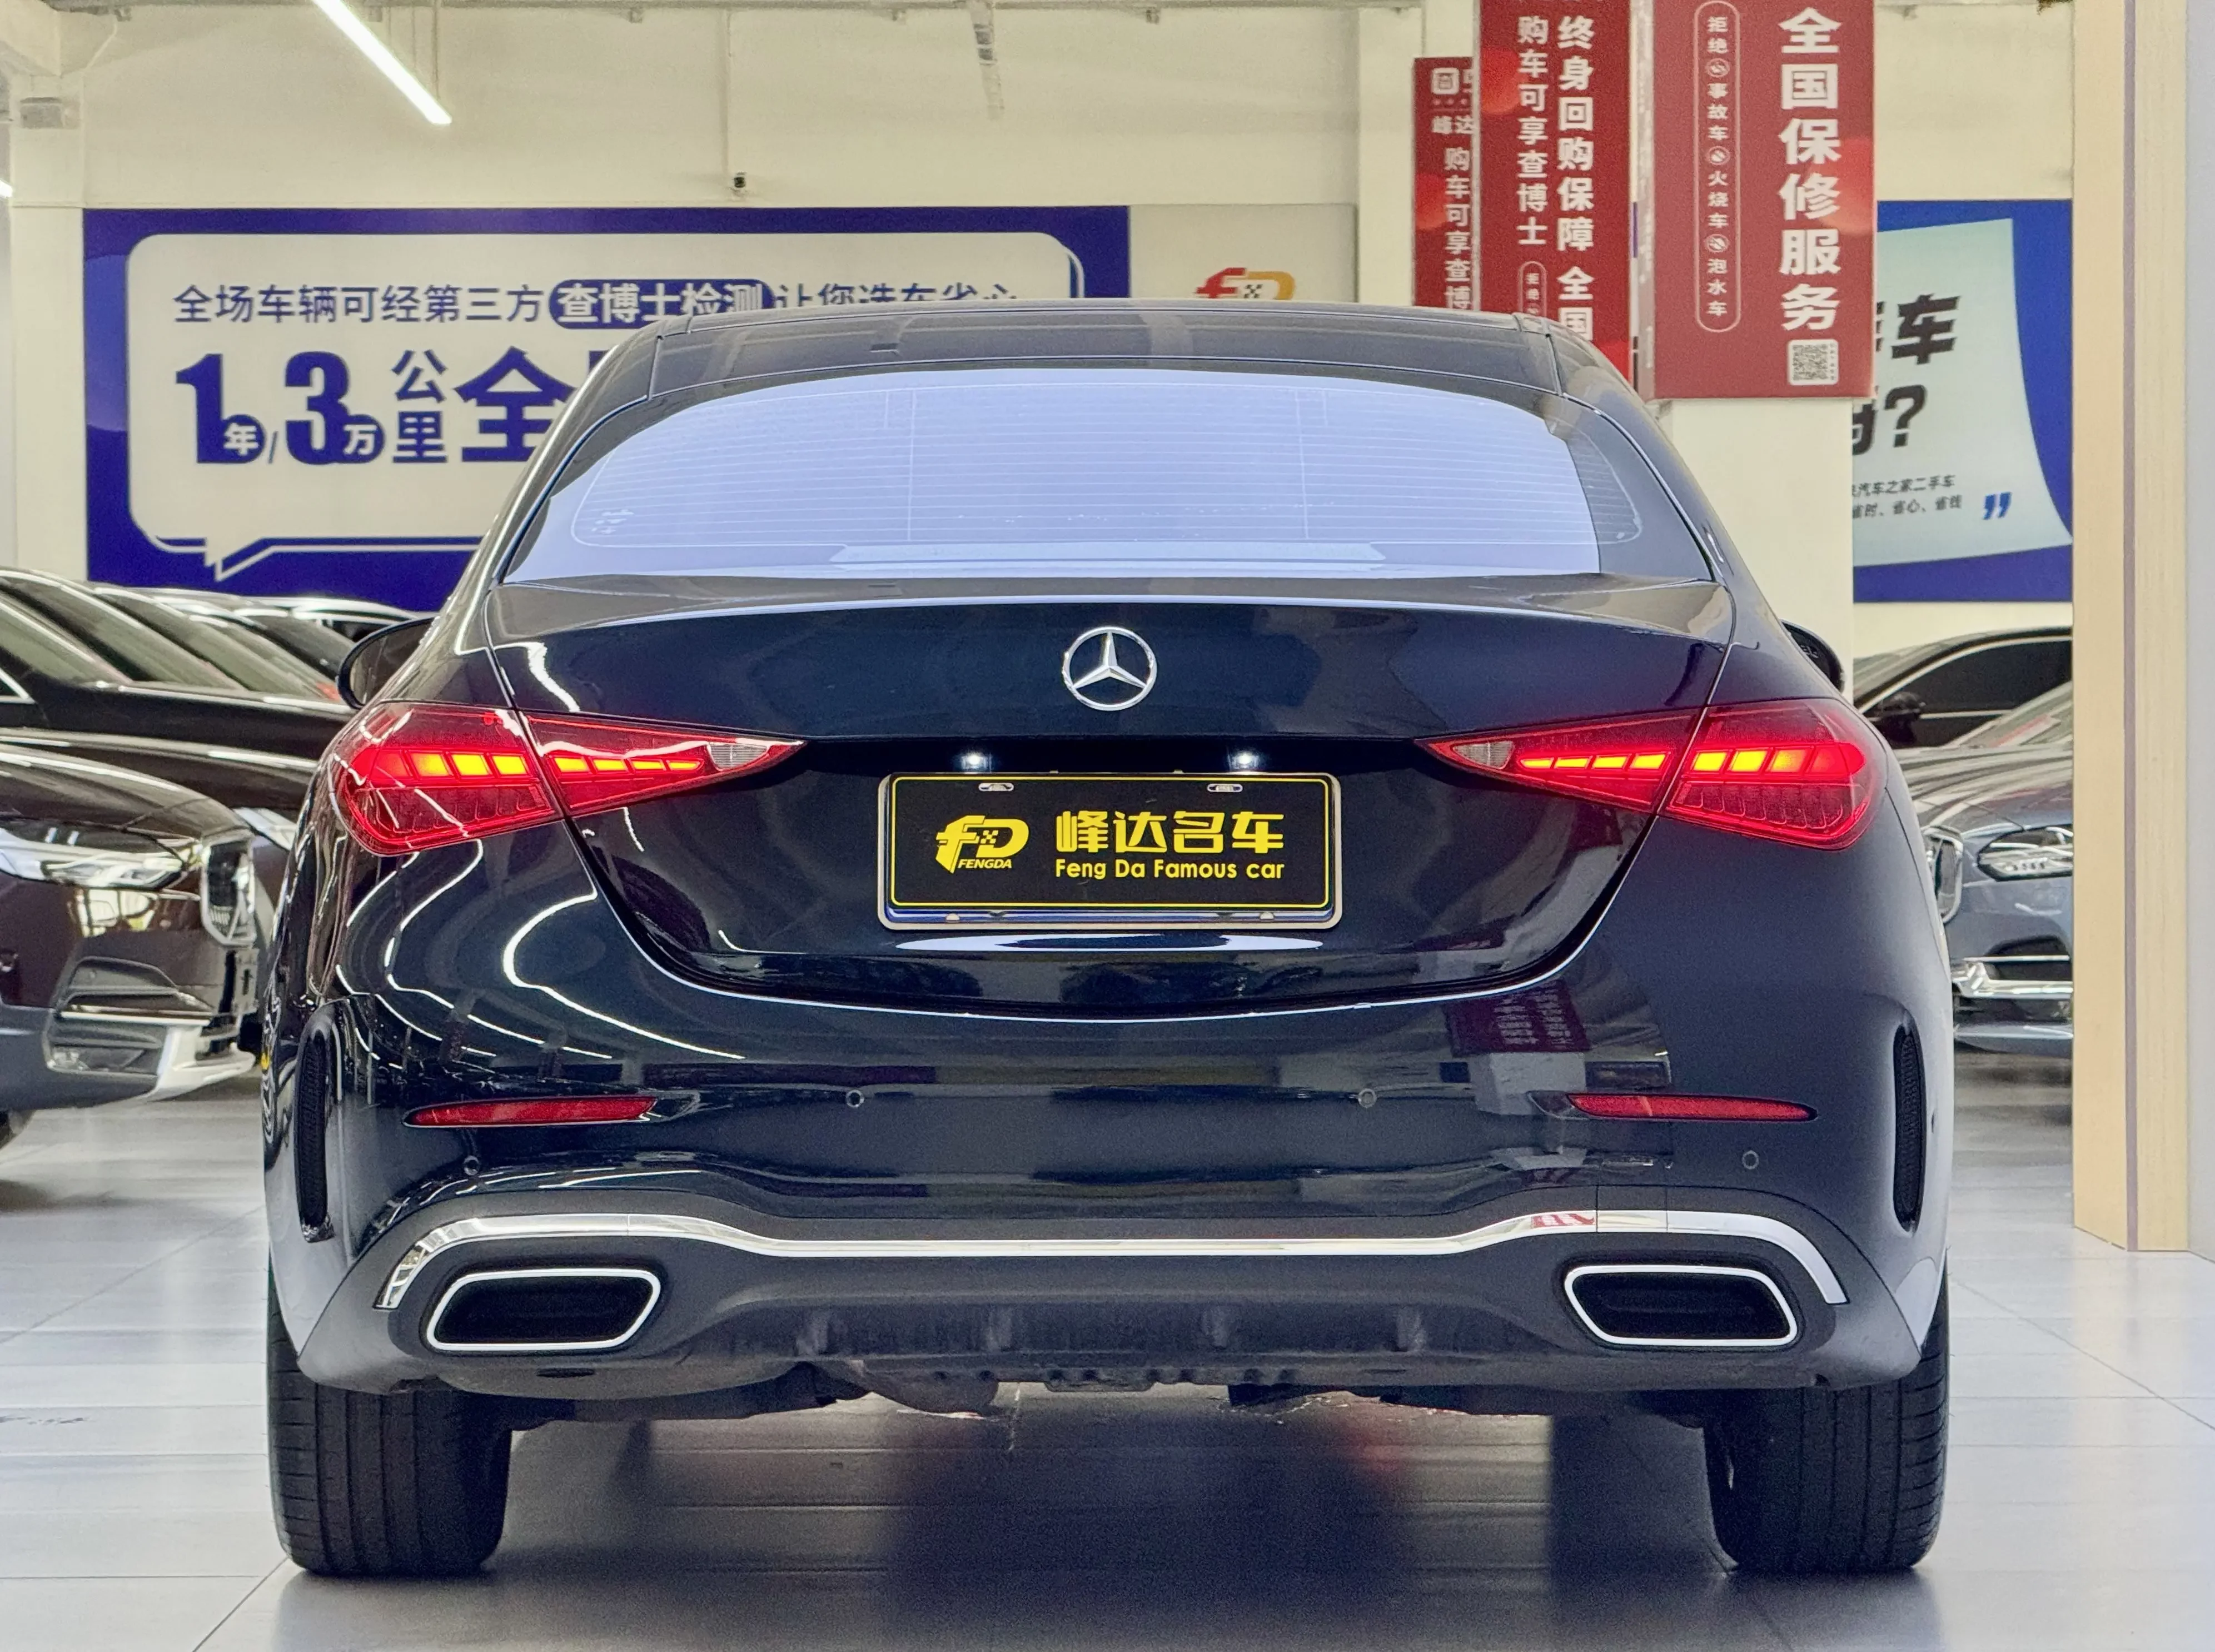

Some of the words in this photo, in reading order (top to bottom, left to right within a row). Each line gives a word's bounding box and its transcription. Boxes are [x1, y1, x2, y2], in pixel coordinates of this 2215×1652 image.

[1517, 16, 1549, 246] 购车可享查博士
[1557, 15, 1595, 252] 终身回购保障
[1779, 7, 1841, 331] 全国保修服务
[1875, 293, 1962, 365] 车
[957, 859, 1013, 869] FENGDA
[1056, 810, 1285, 854] 峰达名车
[1056, 859, 1106, 880] Feng
[1115, 859, 1145, 879] Da
[1154, 859, 1237, 879] Famous
[1247, 863, 1285, 879] car
